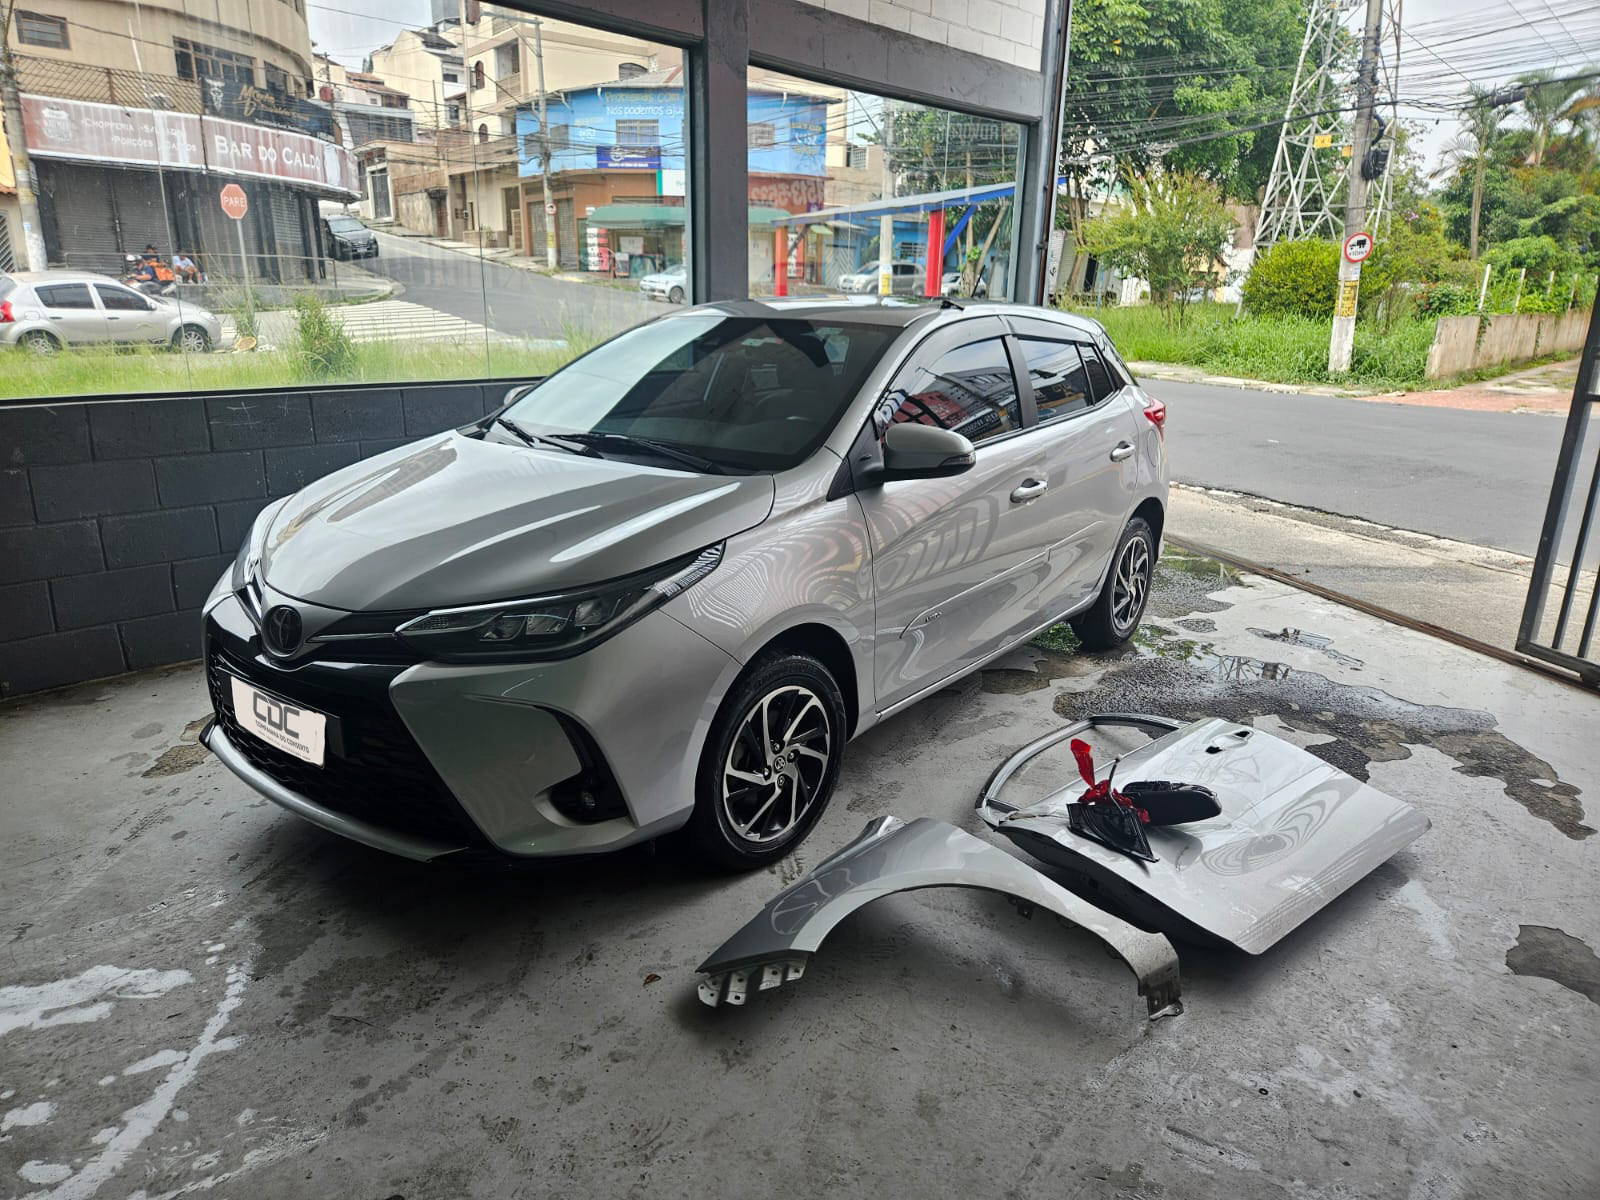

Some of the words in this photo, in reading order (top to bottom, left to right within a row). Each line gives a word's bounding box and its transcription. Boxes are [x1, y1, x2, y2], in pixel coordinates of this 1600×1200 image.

[213, 134, 252, 159] BAR
[258, 146, 277, 163] DO
[223, 196, 245, 208] PARE
